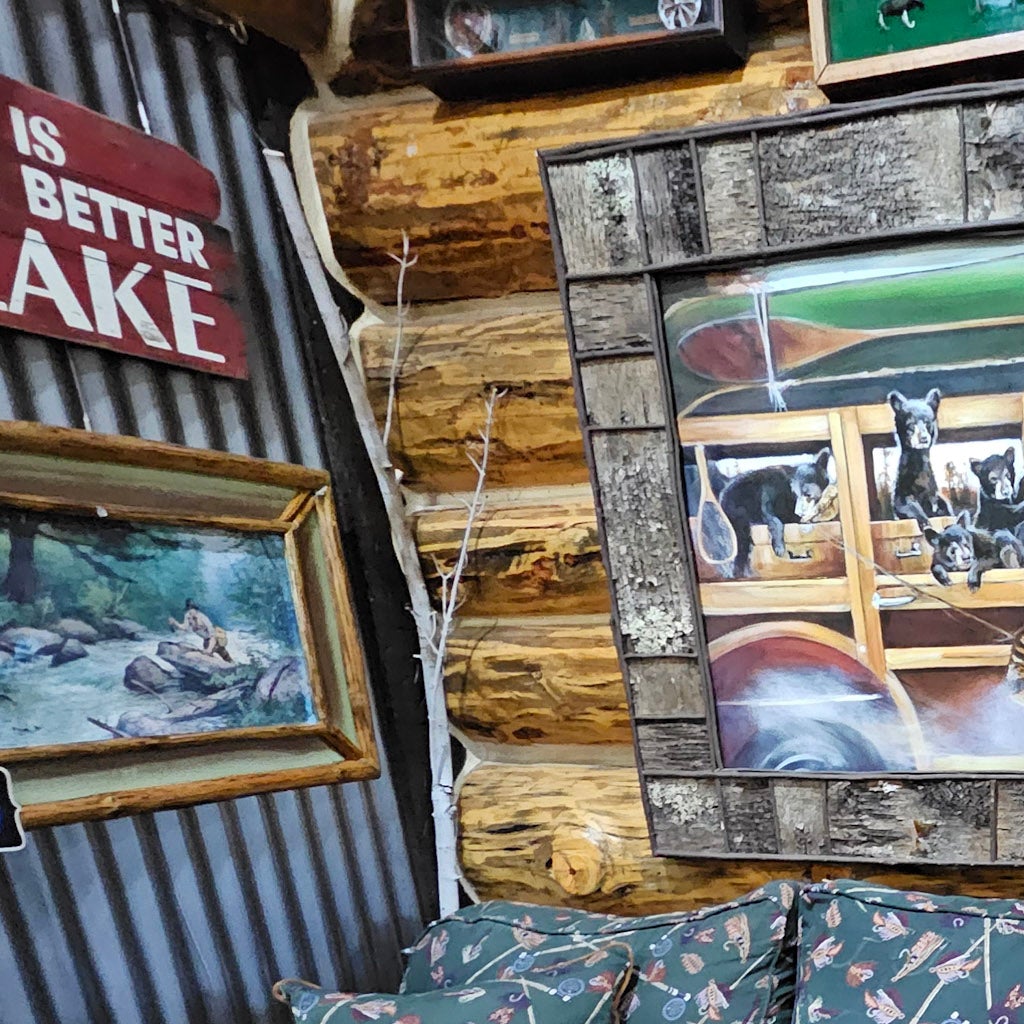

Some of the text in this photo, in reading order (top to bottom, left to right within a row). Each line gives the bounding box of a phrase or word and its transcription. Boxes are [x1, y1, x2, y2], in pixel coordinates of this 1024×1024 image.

[8, 105, 67, 167] IS
[20, 164, 210, 270] BETTER
[0, 227, 226, 364] AKE
